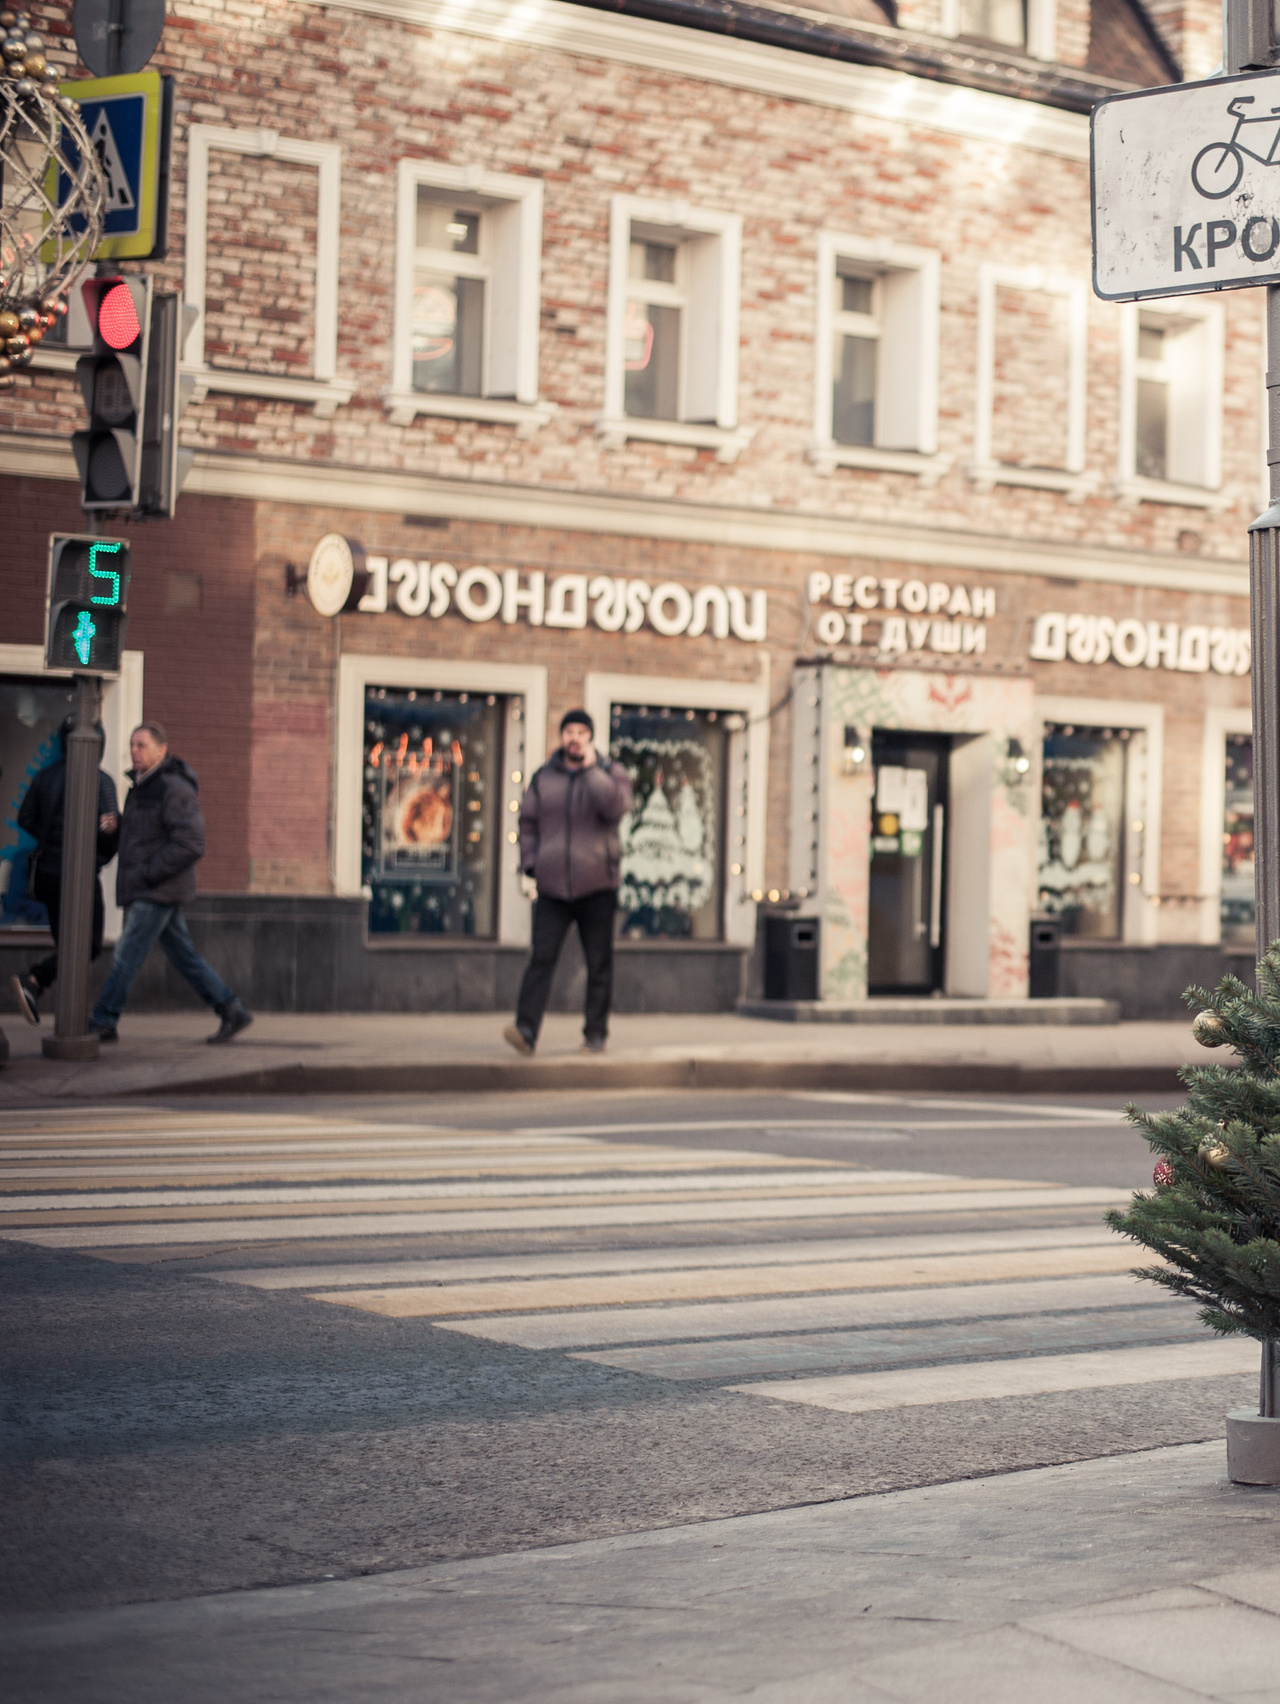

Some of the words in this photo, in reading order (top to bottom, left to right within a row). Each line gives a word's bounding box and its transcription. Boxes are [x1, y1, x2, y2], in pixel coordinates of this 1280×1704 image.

[89, 541, 120, 605] 5
[809, 571, 996, 619] РЕСТОРАН
[818, 611, 869, 645] ОТ
[879, 616, 987, 655] ДУШИ
[1029, 612, 1251, 676] ДЖОНДЖ
